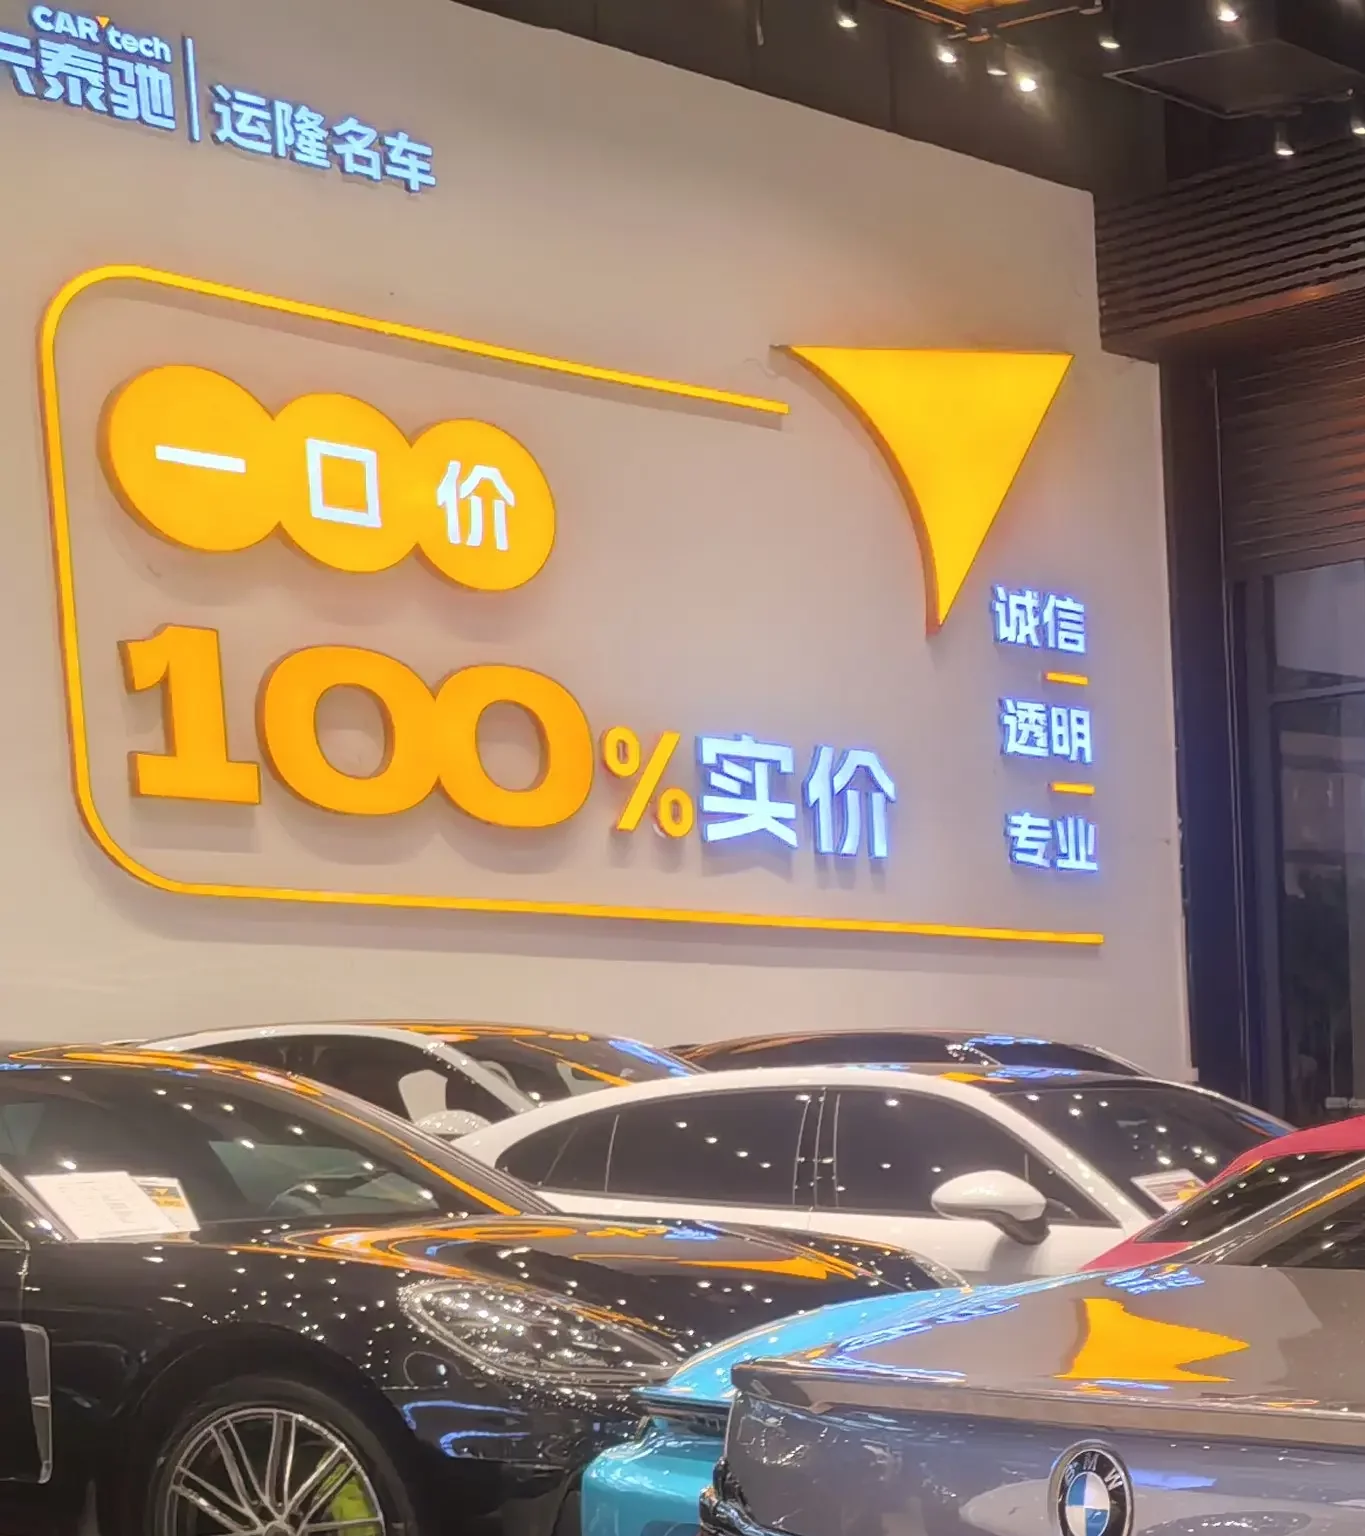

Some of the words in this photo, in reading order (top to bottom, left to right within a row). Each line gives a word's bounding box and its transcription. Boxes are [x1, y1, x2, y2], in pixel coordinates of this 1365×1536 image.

[210, 84, 436, 193] 运隆名车
[155, 437, 515, 552] 一口价
[991, 583, 1087, 654] 诚信
[1000, 697, 1094, 764] 透明
[1007, 812, 1099, 873] 专业
[1064, 1451, 1124, 1491] BMW
